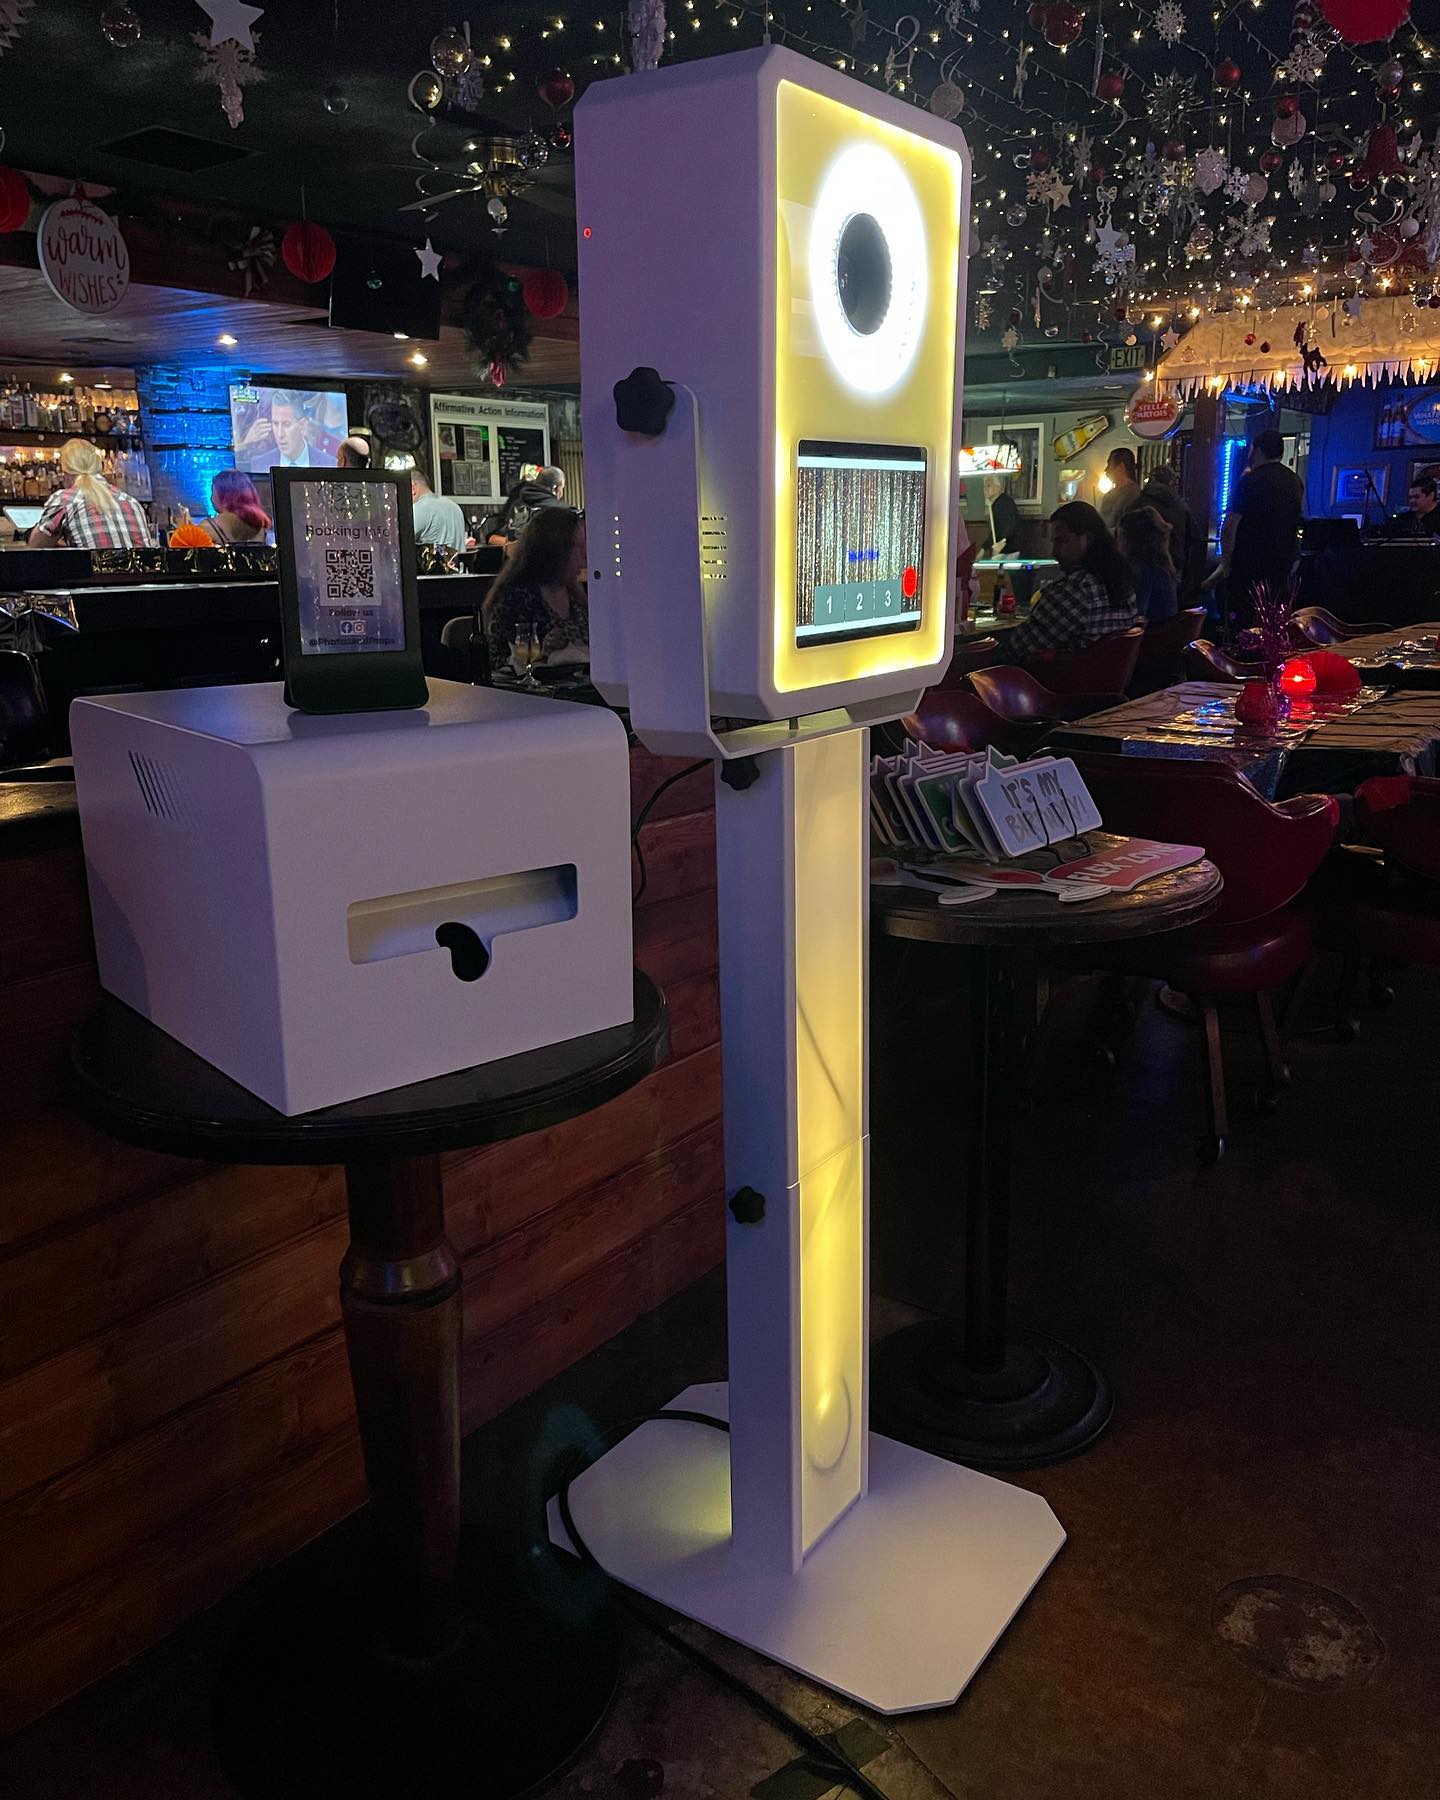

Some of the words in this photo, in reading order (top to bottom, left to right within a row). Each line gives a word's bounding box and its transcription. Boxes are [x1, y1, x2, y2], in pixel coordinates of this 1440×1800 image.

[59, 268, 118, 307] WISHES
[1115, 348, 1140, 368] EXIT
[434, 402, 475, 414] Affirmative
[478, 405, 502, 416] Action
[505, 408, 546, 419] Information
[1136, 409, 1168, 418] ARTOIS
[1138, 402, 1168, 412] STELLA
[306, 525, 361, 539] Booking
[365, 526, 390, 537] Info
[826, 595, 833, 614] 1
[856, 593, 863, 611] 2
[885, 590, 892, 607] 3
[1001, 779, 1036, 810] IT'S
[1037, 769, 1064, 798] MY
[1066, 861, 1133, 882] FLEX
[1113, 843, 1185, 864] ZONE
